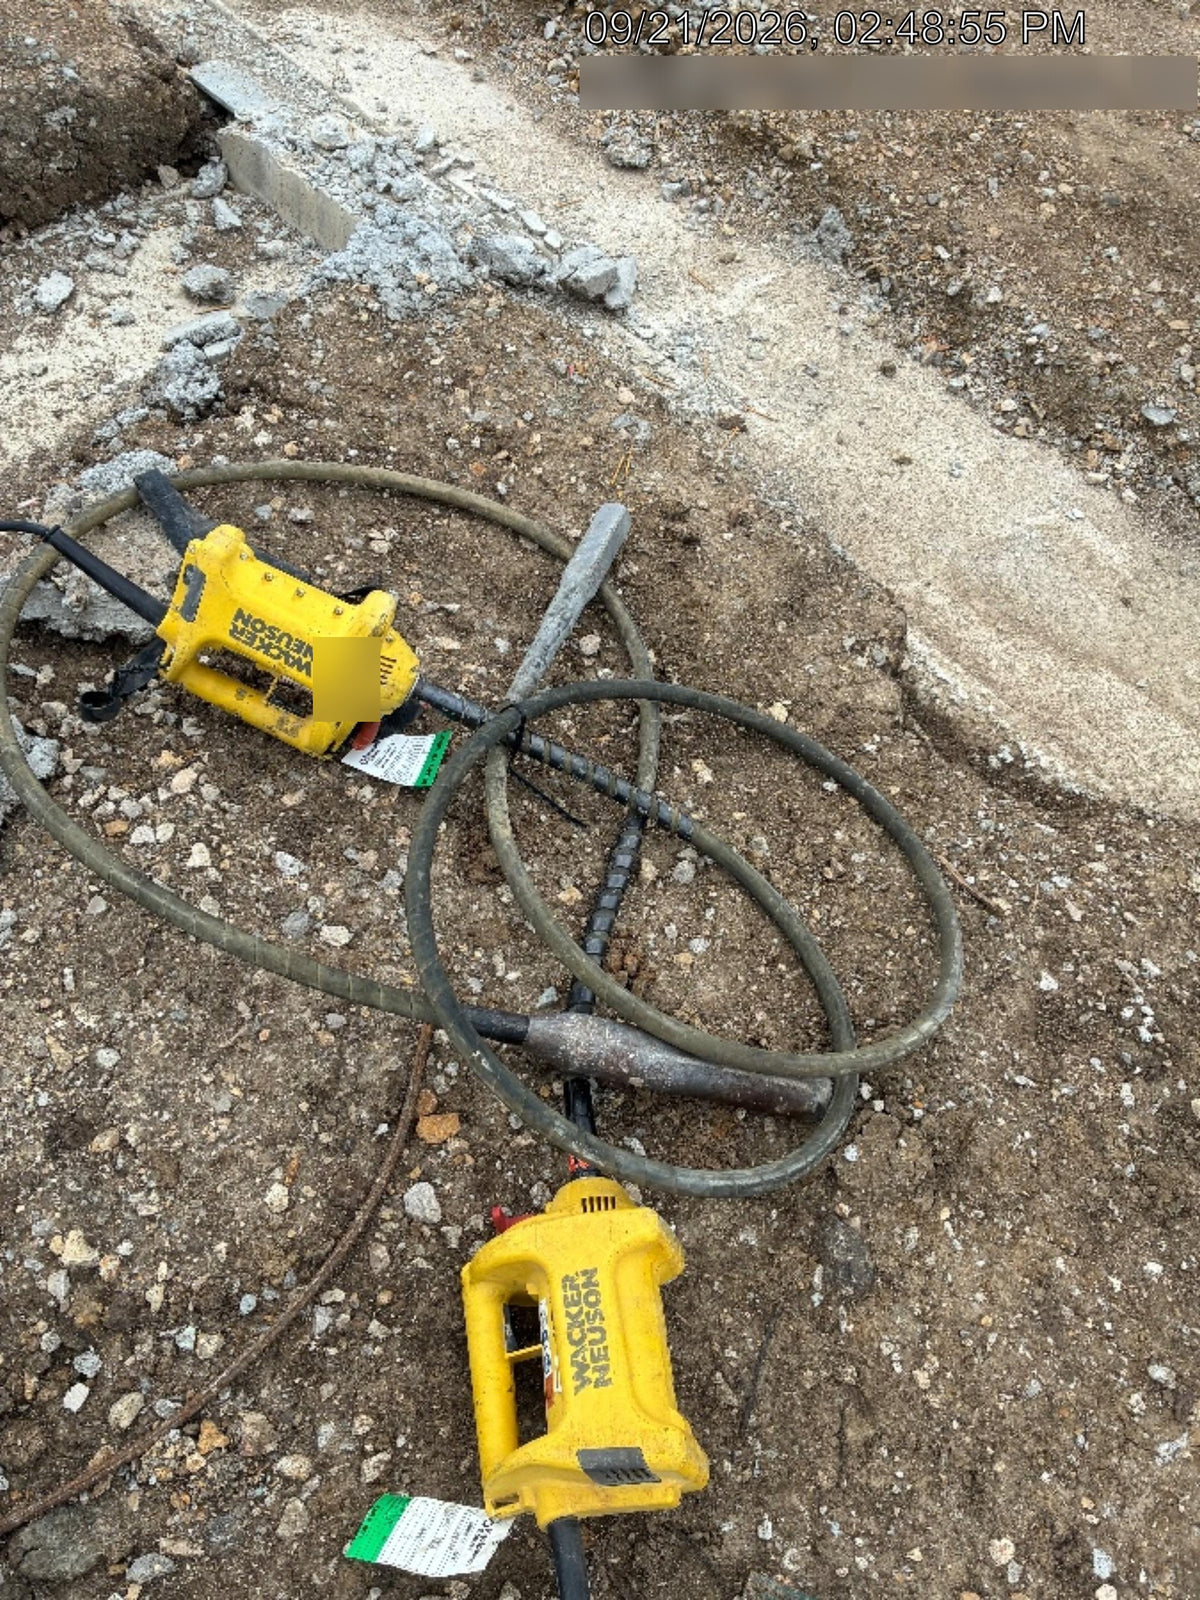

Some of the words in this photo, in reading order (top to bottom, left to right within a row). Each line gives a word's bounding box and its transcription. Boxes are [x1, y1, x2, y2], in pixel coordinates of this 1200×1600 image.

[229, 621, 312, 678] WACKER
[231, 607, 313, 662] NEUSON
[561, 1270, 593, 1396] WACKER
[580, 1266, 614, 1389] NEUSON
